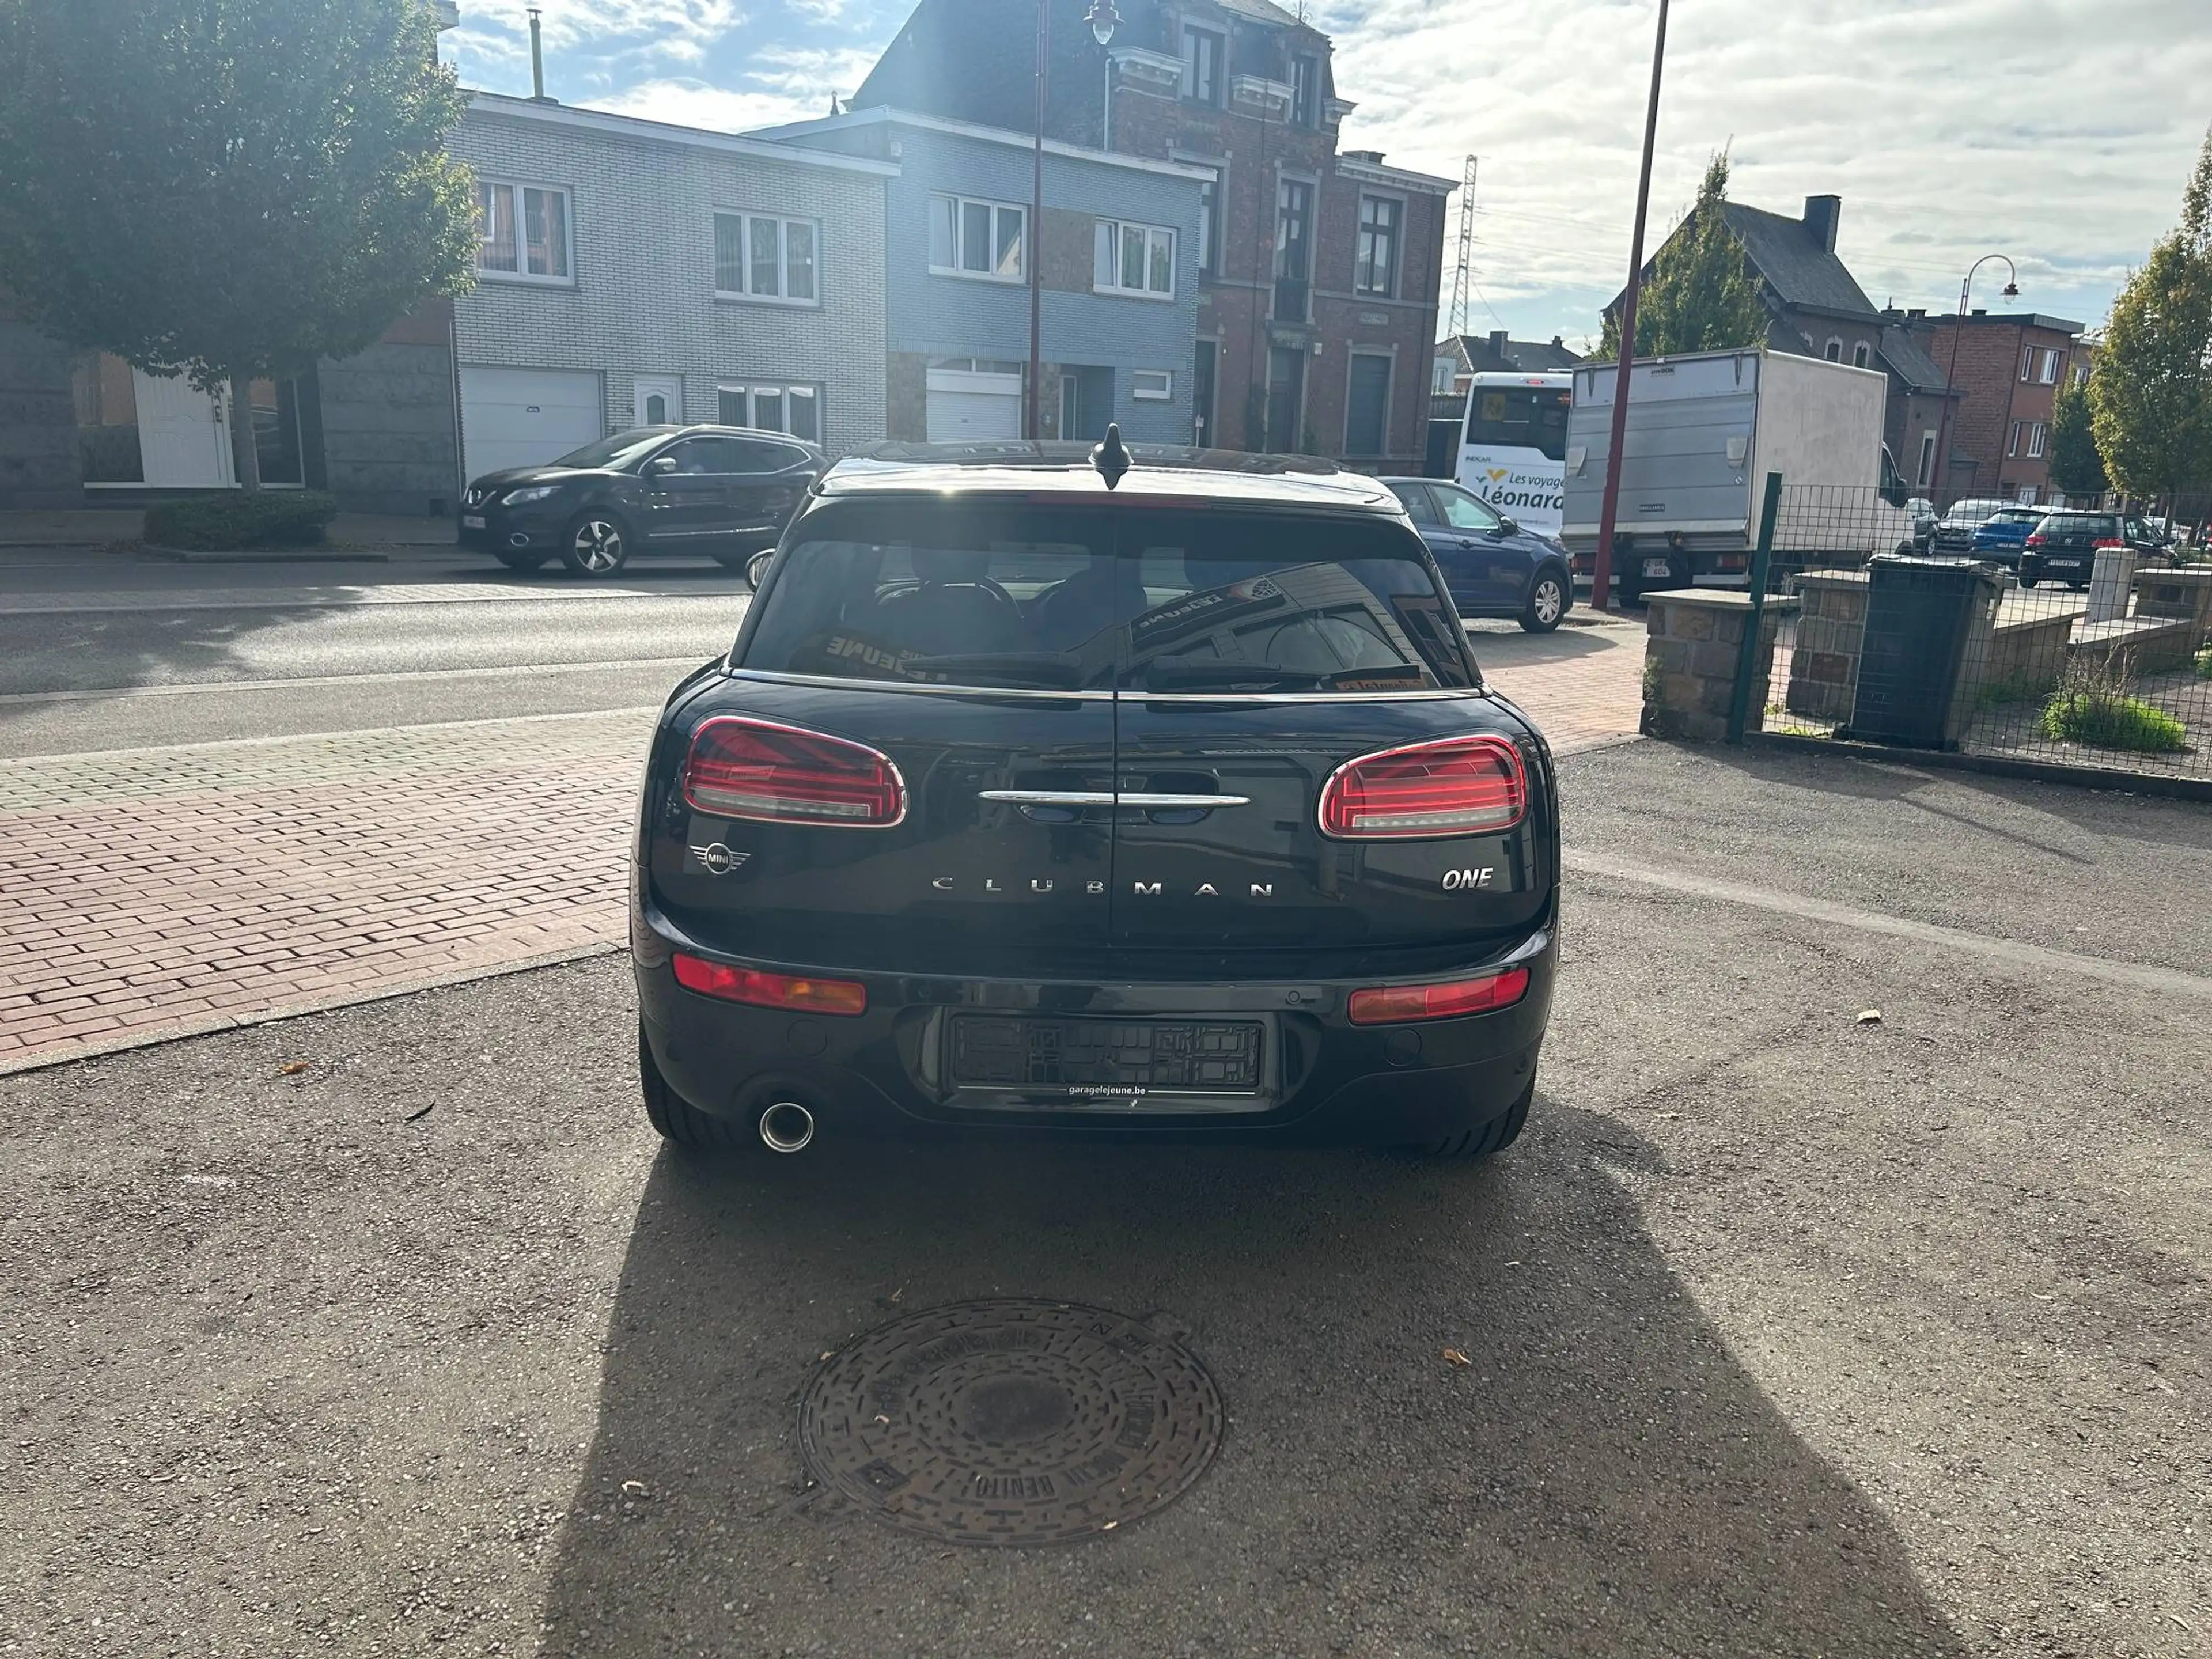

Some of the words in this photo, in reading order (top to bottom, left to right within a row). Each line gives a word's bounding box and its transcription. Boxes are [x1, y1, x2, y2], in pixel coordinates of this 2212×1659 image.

[1509, 472, 1525, 484] Les
[709, 854, 728, 864] MINI
[1442, 867, 1493, 890] ONE
[932, 877, 1272, 896] CLUBMAN
[1069, 1085, 1146, 1096] garagelejeune.be
